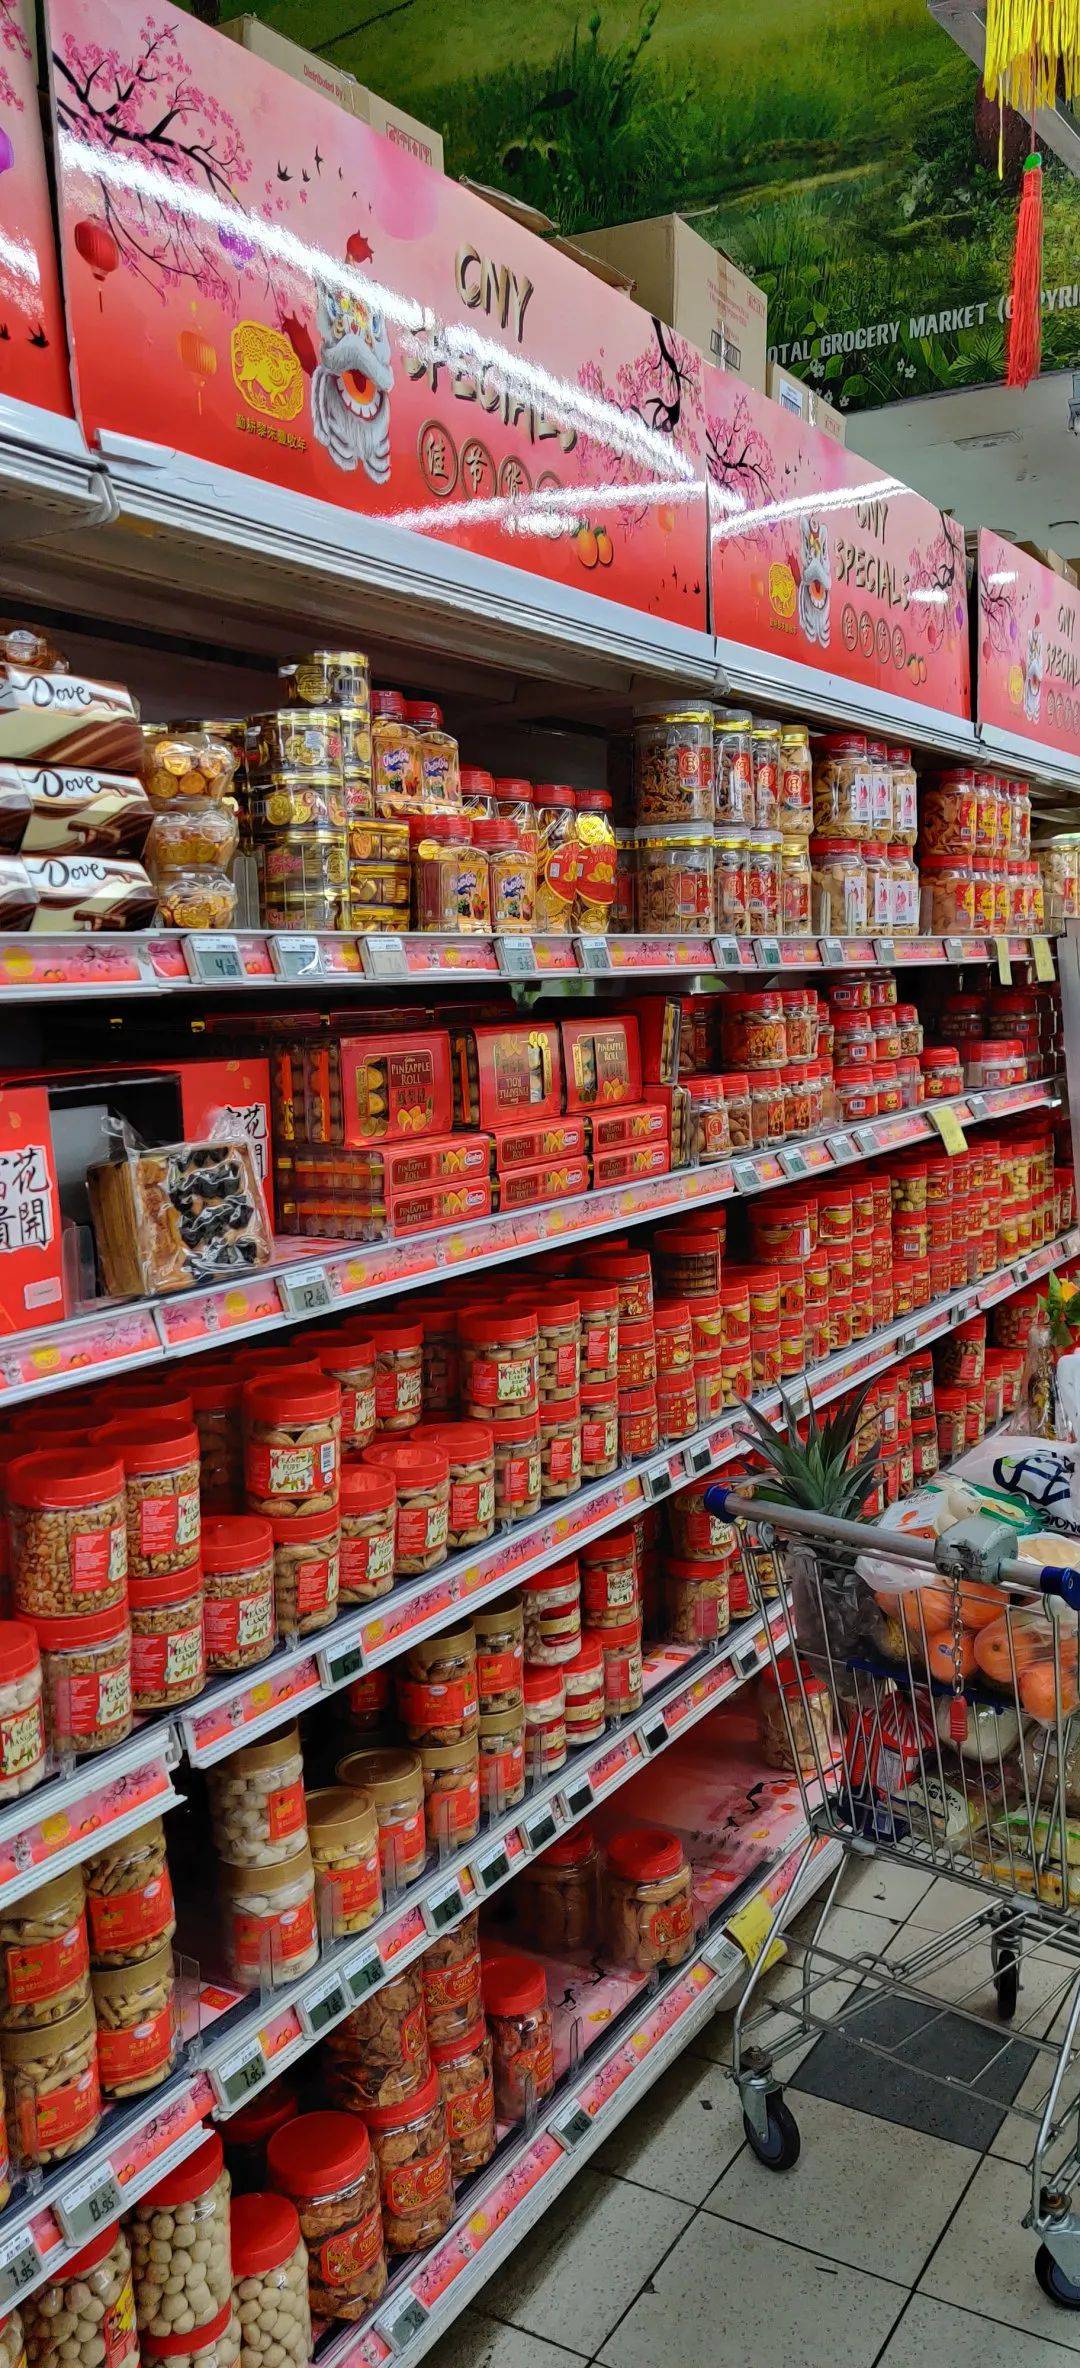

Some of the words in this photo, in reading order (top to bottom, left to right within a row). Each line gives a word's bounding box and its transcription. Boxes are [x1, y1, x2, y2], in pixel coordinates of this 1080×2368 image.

[455, 243, 534, 343] CNY
[767, 342, 811, 365] OTAL
[820, 321, 900, 358] GROCERY
[909, 302, 989, 340] MARKET
[856, 499, 888, 545] CNY
[834, 537, 910, 612] SPECIALS
[1058, 604, 1076, 642] CNY
[1046, 643, 1080, 690] SPECIAL
[18, 676, 94, 707] Dove
[27, 768, 103, 798] Dove
[32, 859, 108, 888] Dove
[391, 1061, 431, 1075] PINEAPPLE
[400, 1074, 421, 1086] ROLL
[12, 1147, 50, 1246] 花開
[88, 2196, 116, 2222] 8.95
